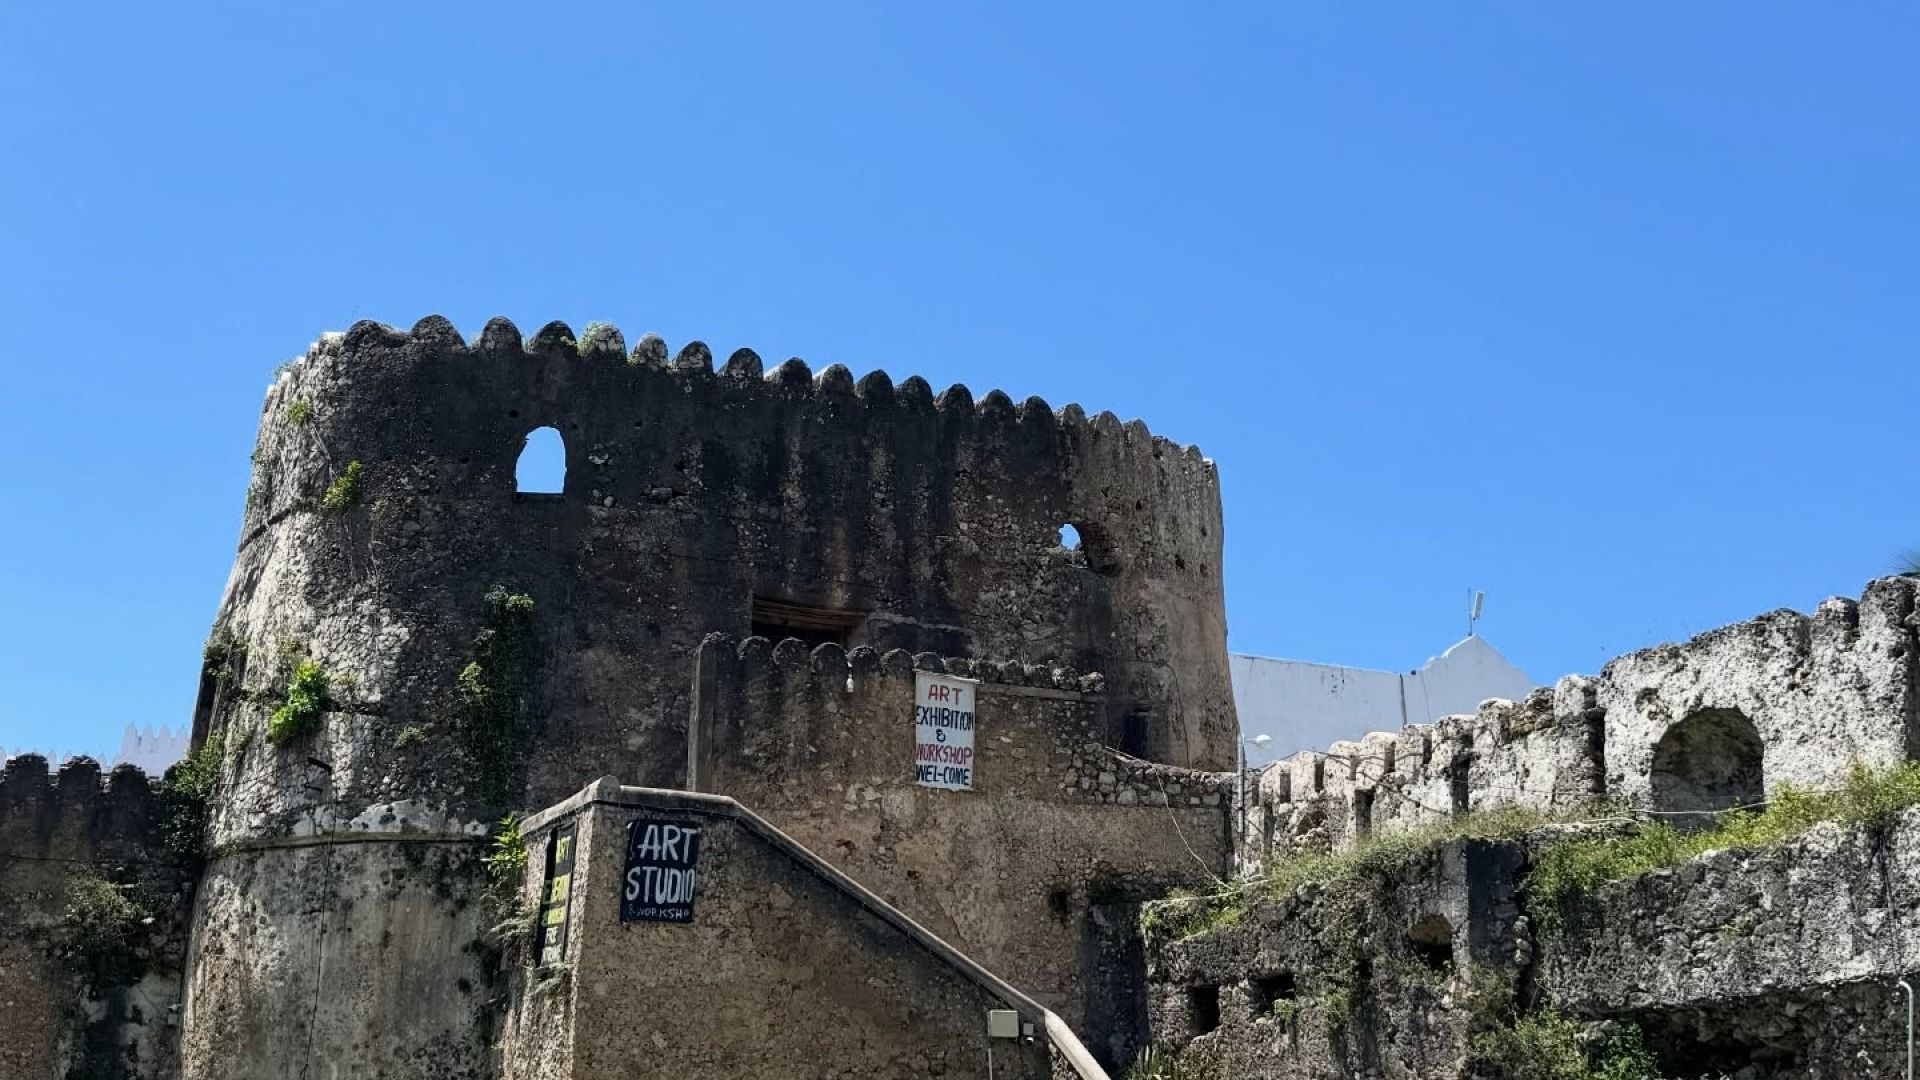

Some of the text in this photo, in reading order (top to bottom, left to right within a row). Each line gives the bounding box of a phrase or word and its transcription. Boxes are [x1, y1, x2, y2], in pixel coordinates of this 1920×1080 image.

[928, 684, 962, 705] ART
[916, 705, 974, 731] EXHIBITION
[916, 743, 973, 765] WORKSHOP
[636, 824, 698, 864] ART
[625, 866, 696, 904] STUDIO
